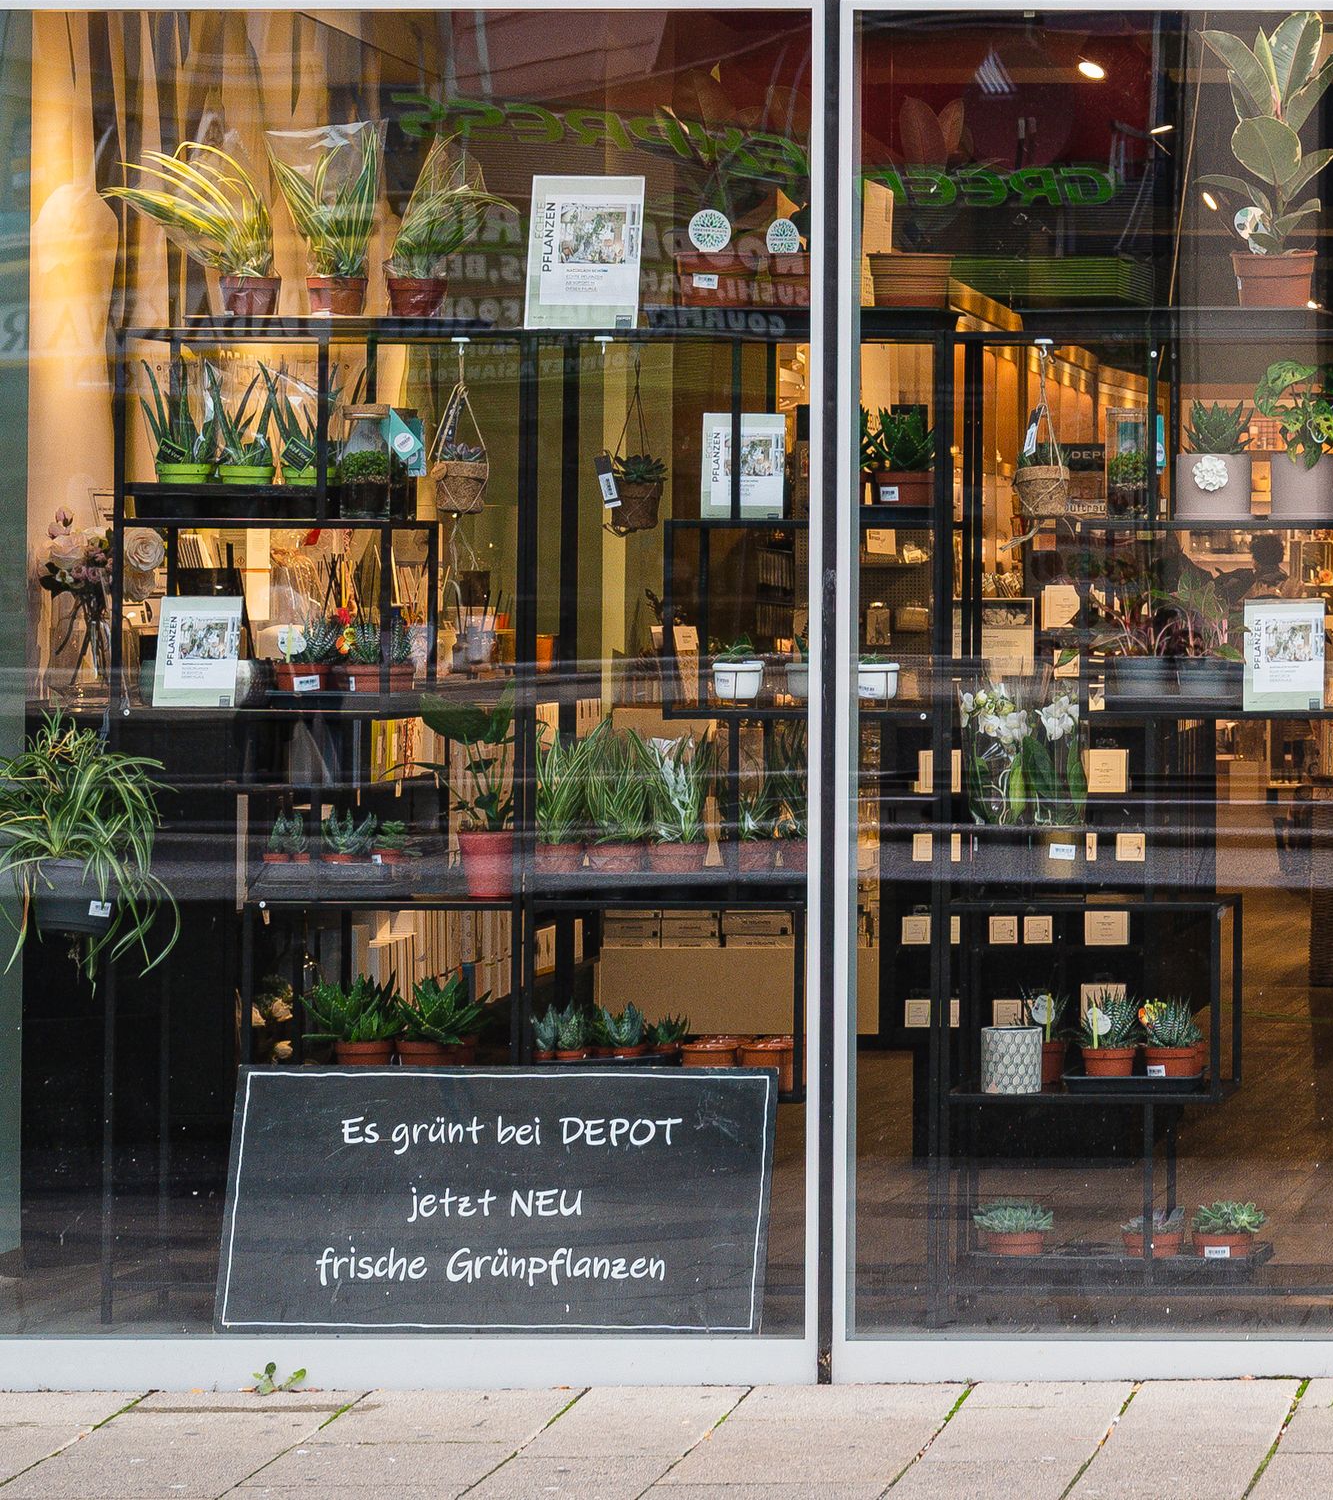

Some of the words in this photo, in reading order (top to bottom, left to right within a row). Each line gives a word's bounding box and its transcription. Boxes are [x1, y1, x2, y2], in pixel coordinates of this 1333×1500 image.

[542, 202, 556, 272] PFLANZEN
[712, 432, 721, 482] PFLANZEN
[1071, 451, 1105, 459] DEP
[166, 616, 178, 666] PFLANZEN
[1253, 619, 1262, 669] PFLANZEN
[341, 1116, 380, 1145] Es
[391, 1116, 485, 1155] grünt
[497, 1116, 541, 1145] bei
[558, 1117, 684, 1146] DEPOT
[407, 1186, 497, 1223] jetzt
[510, 1189, 583, 1217] NEU
[315, 1249, 428, 1287] frische
[445, 1246, 666, 1287] Grünpflanzen
